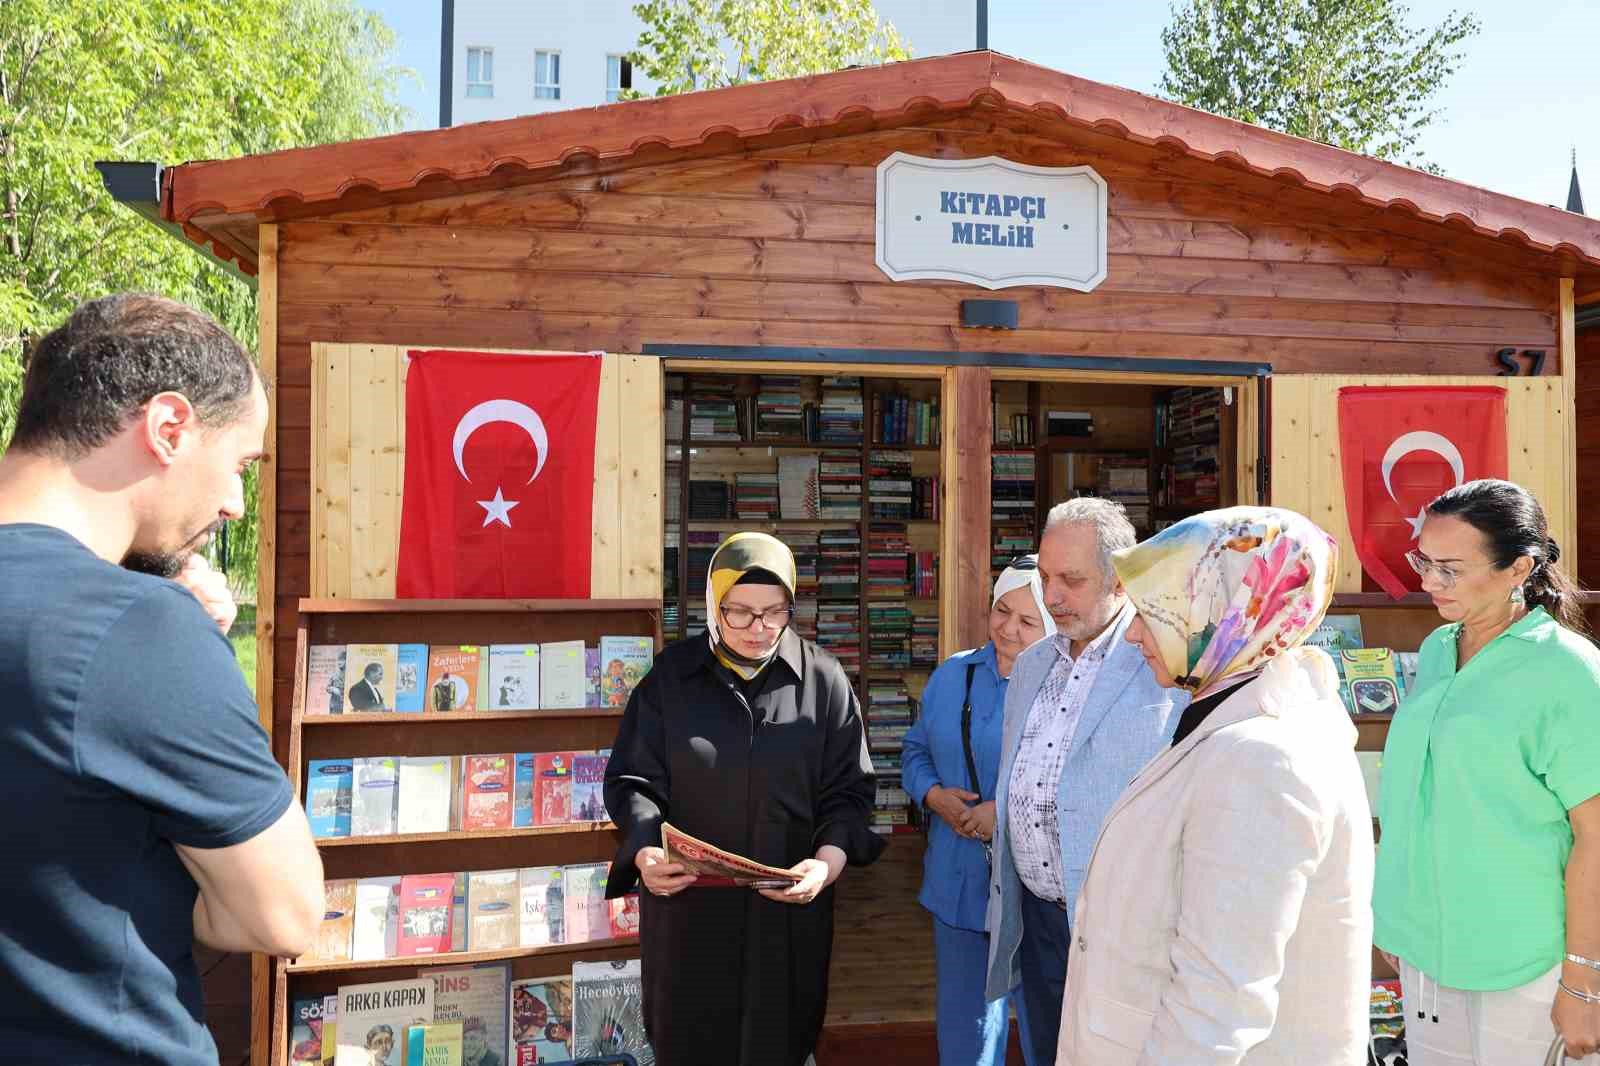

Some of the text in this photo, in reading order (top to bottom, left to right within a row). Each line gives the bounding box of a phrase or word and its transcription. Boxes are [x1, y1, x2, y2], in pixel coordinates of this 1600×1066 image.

[434, 975, 471, 993] İNS
[345, 993, 381, 1013] ARKA
[384, 987, 426, 1009] KAPAK
